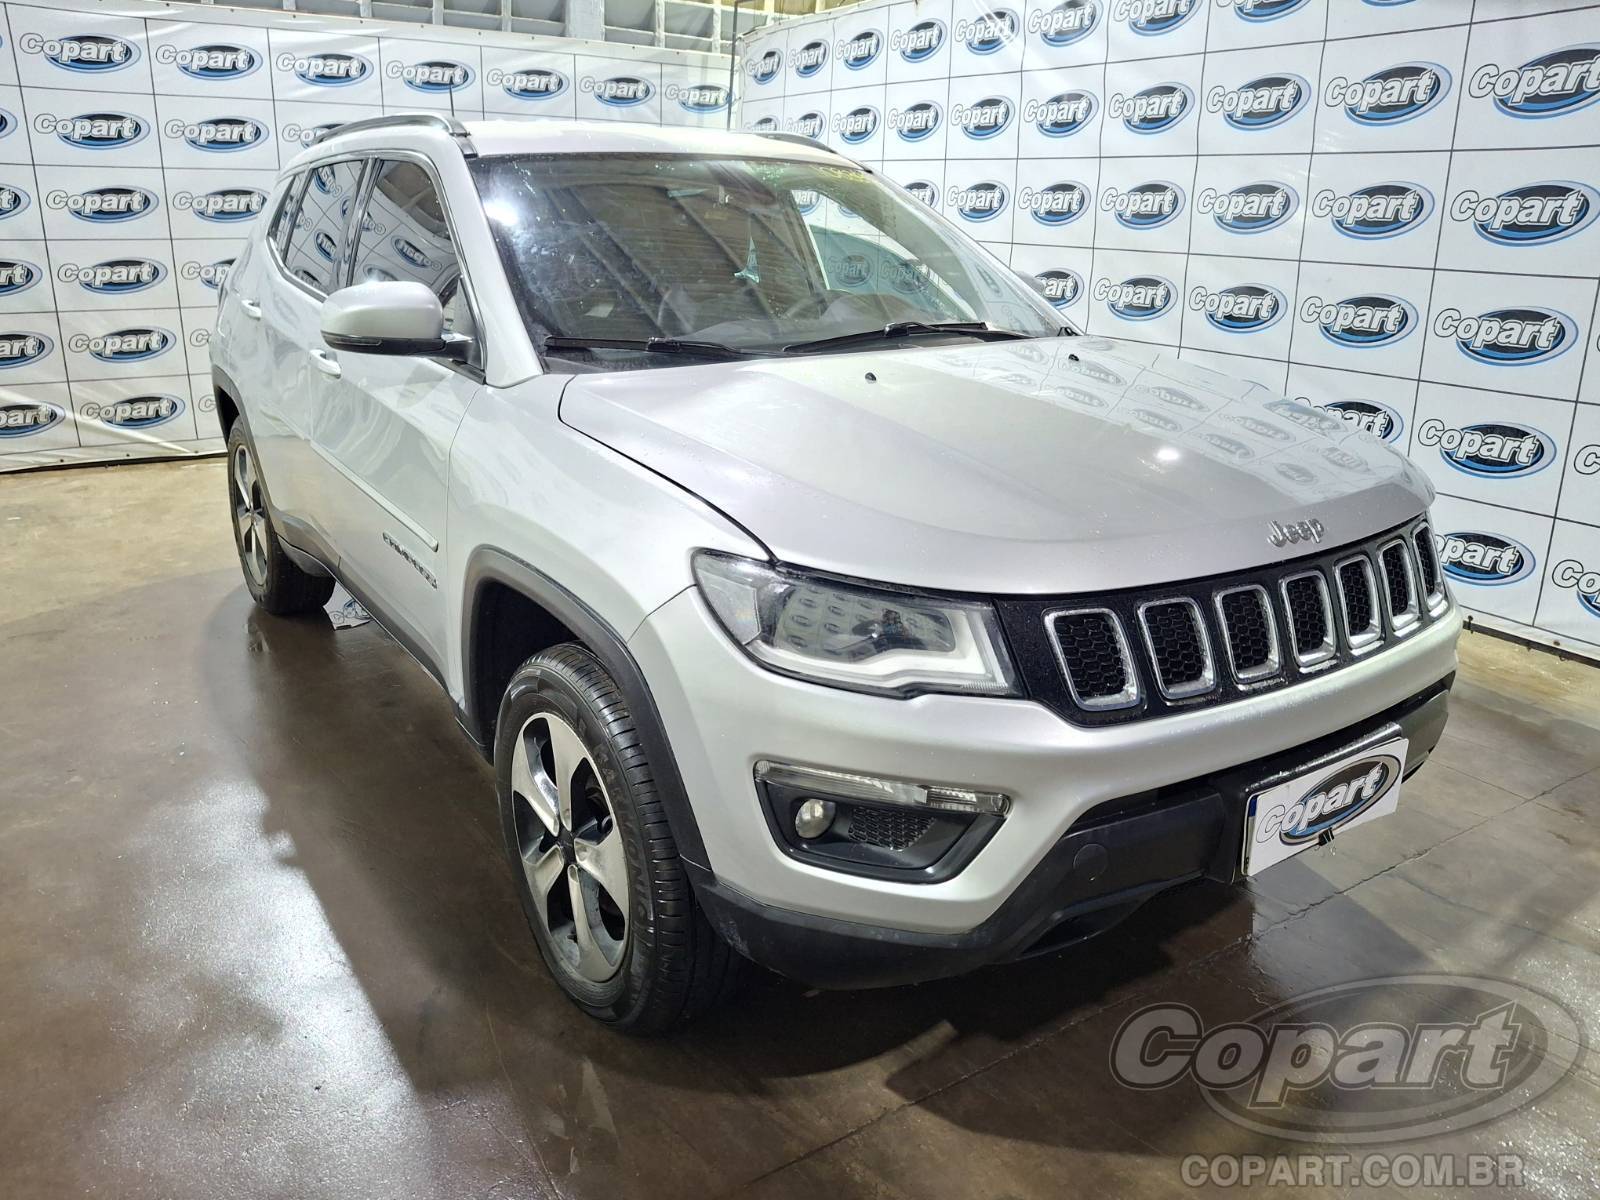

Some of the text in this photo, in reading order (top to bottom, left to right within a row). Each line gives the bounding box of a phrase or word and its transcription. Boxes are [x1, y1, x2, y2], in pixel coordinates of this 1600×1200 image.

[954, 12, 1015, 50] Copart
[1028, 1, 1094, 37] Copart
[20, 33, 127, 62] Copart
[834, 31, 878, 62] Copart
[890, 24, 940, 58] Copart
[155, 44, 251, 70] Copart
[276, 52, 363, 78] Copart
[386, 60, 466, 87] Copart
[487, 68, 562, 92] Copart
[580, 75, 650, 99] Copart
[1469, 55, 1600, 105] Copart
[664, 83, 729, 104] Copart
[1109, 88, 1185, 124] Copart
[1206, 80, 1299, 121] Copart
[1325, 69, 1435, 114] Copart
[831, 109, 875, 136] Copart
[887, 105, 936, 136] Copart
[951, 100, 1008, 131] Copart
[1024, 96, 1090, 127] Copart
[34, 114, 137, 141] Copart
[164, 119, 257, 144] Copart
[46, 190, 147, 216] Copart
[172, 191, 263, 215] Copart
[947, 186, 1001, 212] Copart
[1018, 186, 1082, 216] Copart
[1100, 187, 1175, 218] Copart
[1197, 188, 1287, 222] Copart
[1312, 188, 1419, 224] Copart
[1450, 189, 1584, 231] Copart
[57, 261, 154, 287] Copart
[181, 261, 230, 281] Cop
[1094, 277, 1167, 310] Copart
[1188, 286, 1276, 318] Copart
[1300, 296, 1404, 332] Copart
[1433, 308, 1560, 349] Copart
[68, 329, 163, 358] Copart
[80, 395, 174, 424] Copart
[1418, 418, 1540, 465] Copart
[1267, 517, 1325, 548] Jeep
[1256, 761, 1384, 843] Copart
